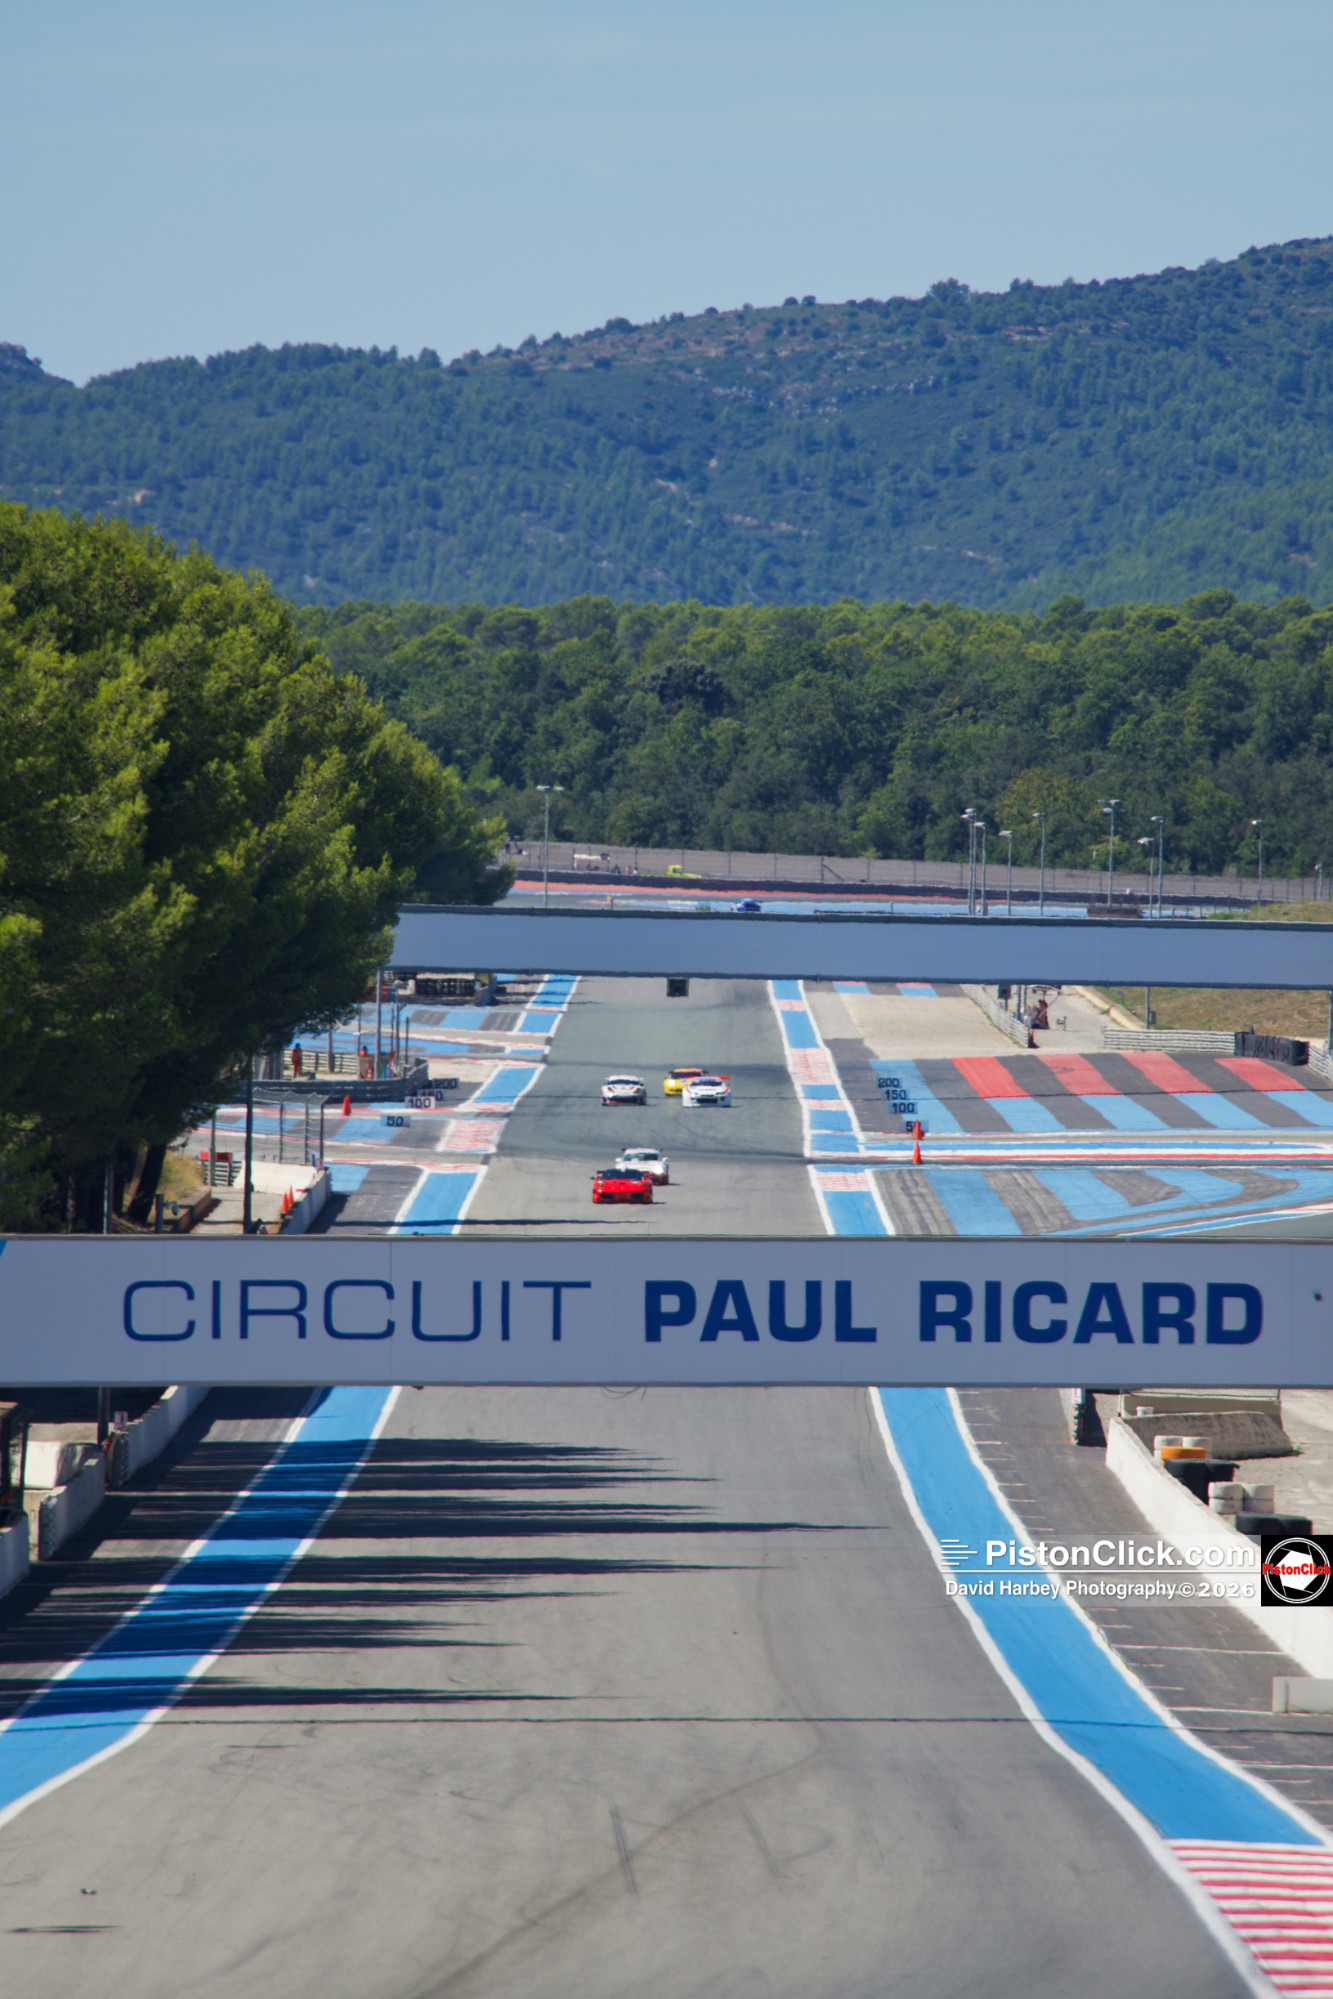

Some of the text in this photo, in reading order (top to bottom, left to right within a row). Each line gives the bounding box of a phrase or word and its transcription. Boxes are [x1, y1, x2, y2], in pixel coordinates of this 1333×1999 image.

[435, 1079, 457, 1089] 200
[878, 1078, 900, 1088] 200
[885, 1089, 907, 1100] 150
[408, 1097, 431, 1108] 100
[892, 1103, 915, 1113] 100
[386, 1116, 404, 1127] 50
[122, 1279, 1264, 1345] CIRCUIT PAUL RICARD
